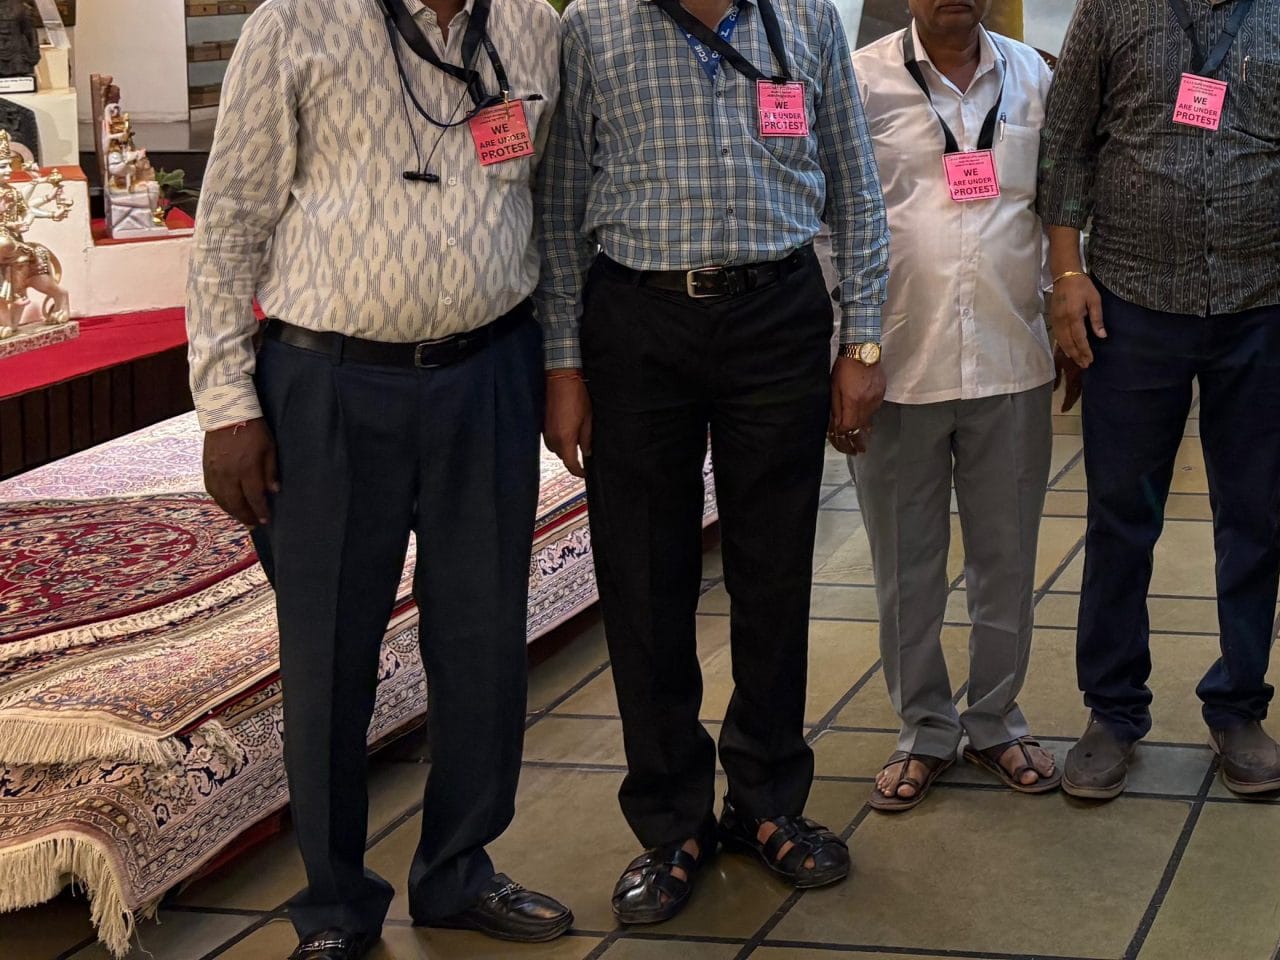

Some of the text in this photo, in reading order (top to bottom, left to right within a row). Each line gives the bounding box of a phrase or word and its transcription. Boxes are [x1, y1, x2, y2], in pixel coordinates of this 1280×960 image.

[775, 101, 789, 109] WE
[1194, 96, 1208, 105] WE
[1194, 106, 1217, 117] UNDER
[1176, 111, 1217, 126] PROTEST
[491, 123, 510, 135] WE
[764, 121, 804, 130] PROTEST
[480, 132, 526, 150] ARE UNDER
[481, 141, 529, 160] PROTEST
[963, 168, 978, 177] WE
[967, 177, 991, 185] UNDER
[954, 185, 994, 196] PROTEST
